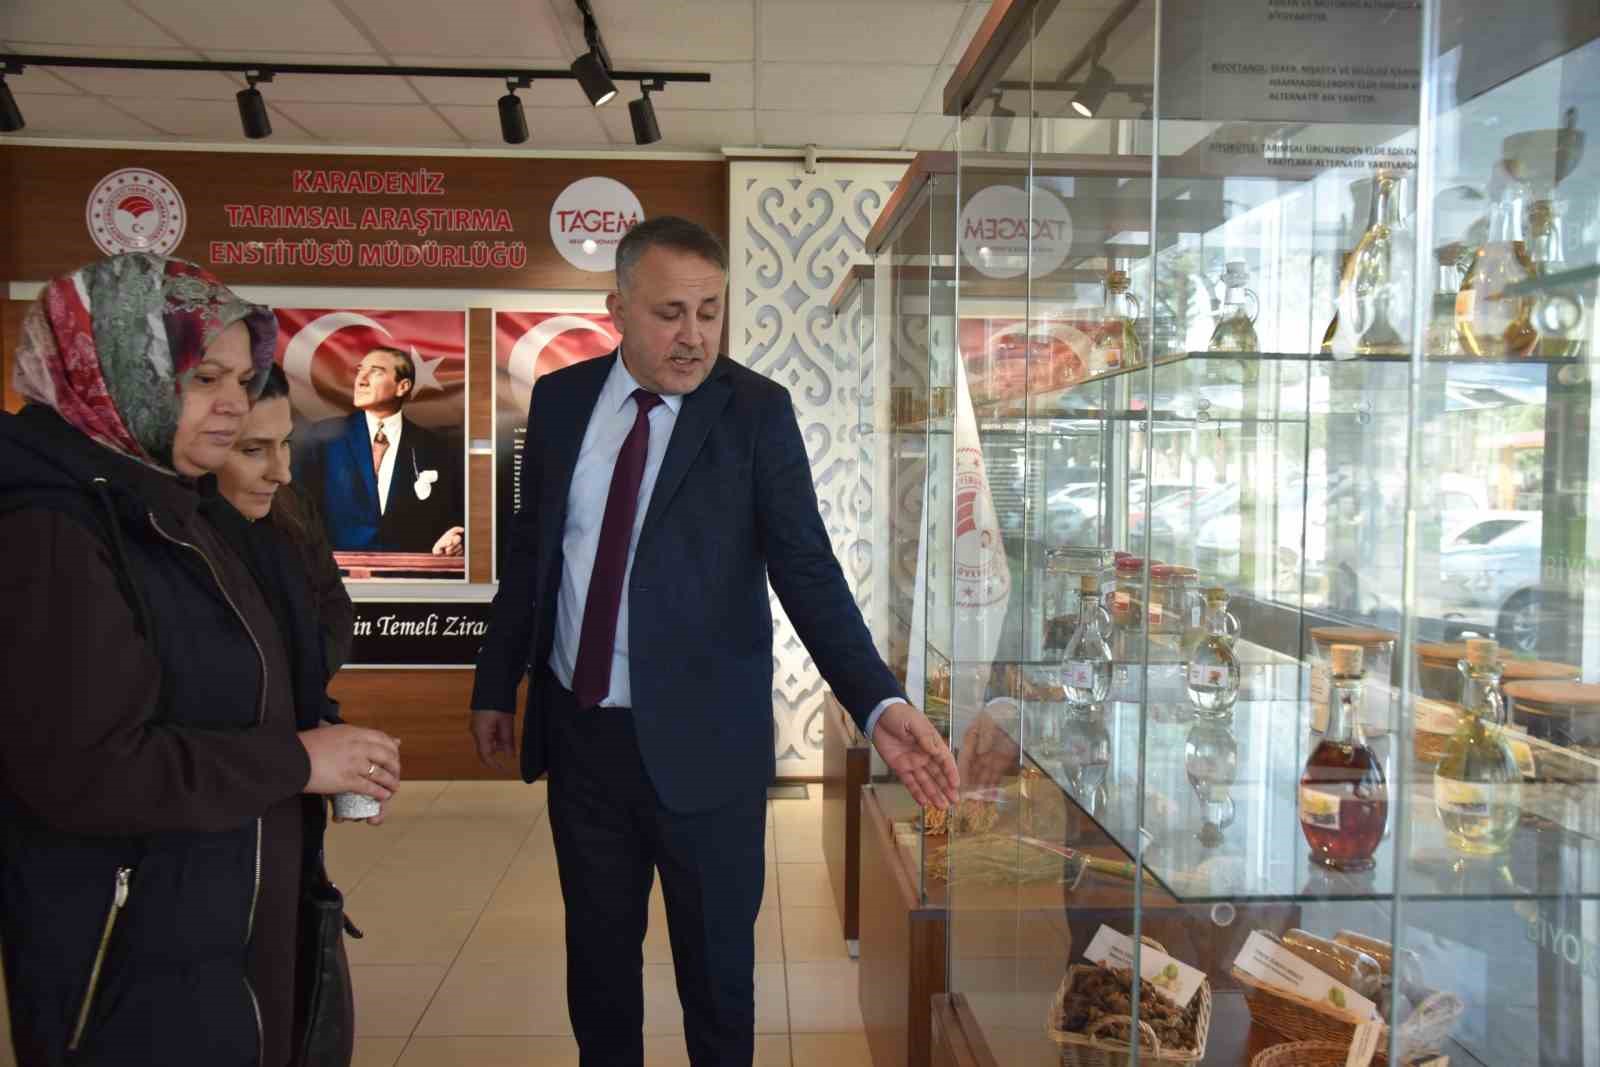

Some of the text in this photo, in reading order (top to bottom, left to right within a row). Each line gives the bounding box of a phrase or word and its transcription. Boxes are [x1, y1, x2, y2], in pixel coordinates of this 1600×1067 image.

[291, 167, 445, 195] KARADENİZ
[224, 204, 514, 236] TARIMSAL ARAŞTIRMA
[556, 209, 639, 233] TAGEM
[209, 238, 527, 269] ENSTİTÜSÜ MÜDÜRLÜĞÜ
[376, 613, 439, 636] Temeli
